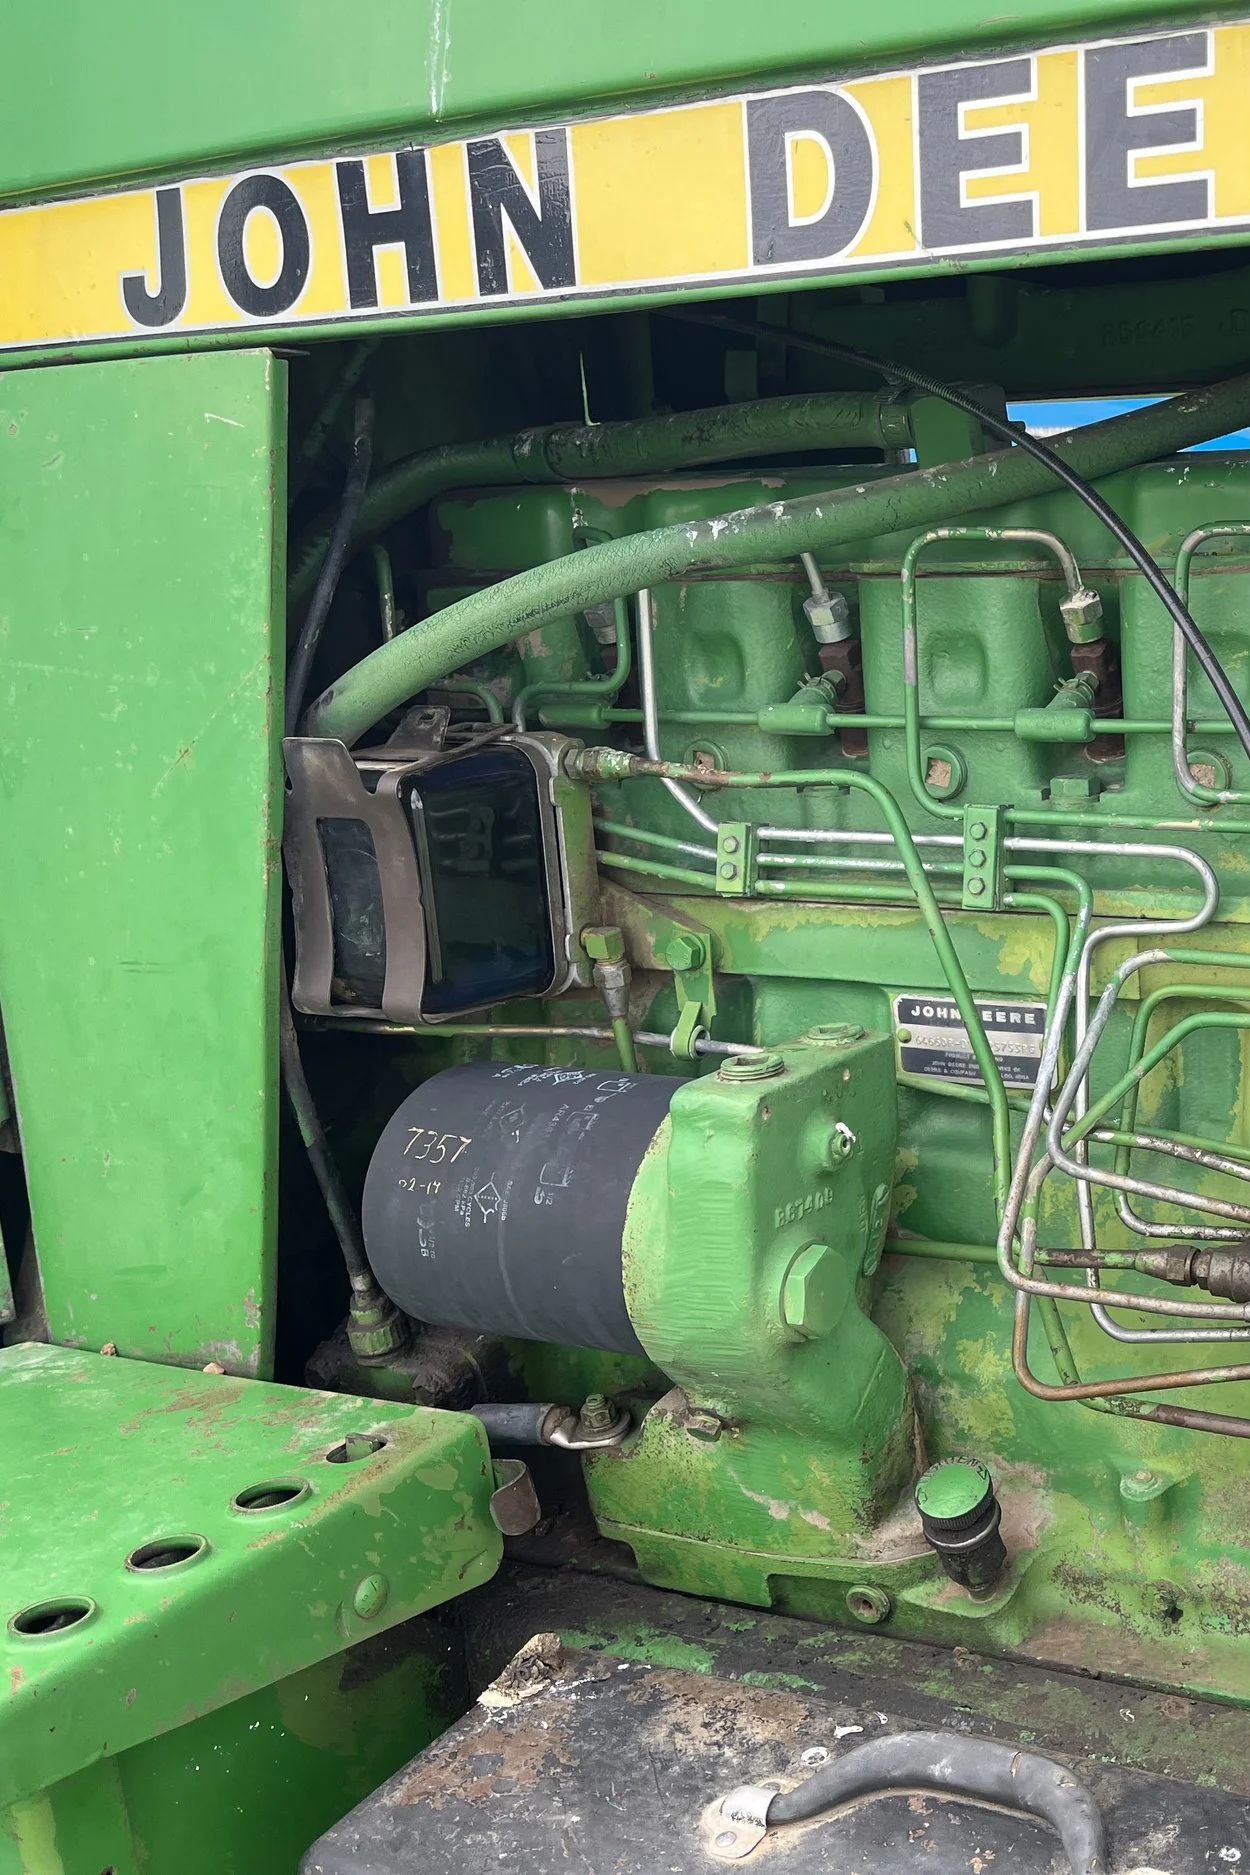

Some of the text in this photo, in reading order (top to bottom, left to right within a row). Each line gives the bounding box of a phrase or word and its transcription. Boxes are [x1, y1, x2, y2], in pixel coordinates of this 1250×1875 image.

[122, 128, 578, 328] JOHN
[911, 1005, 1036, 1025] JOHN EERE
[403, 1127, 473, 1164] 7357
